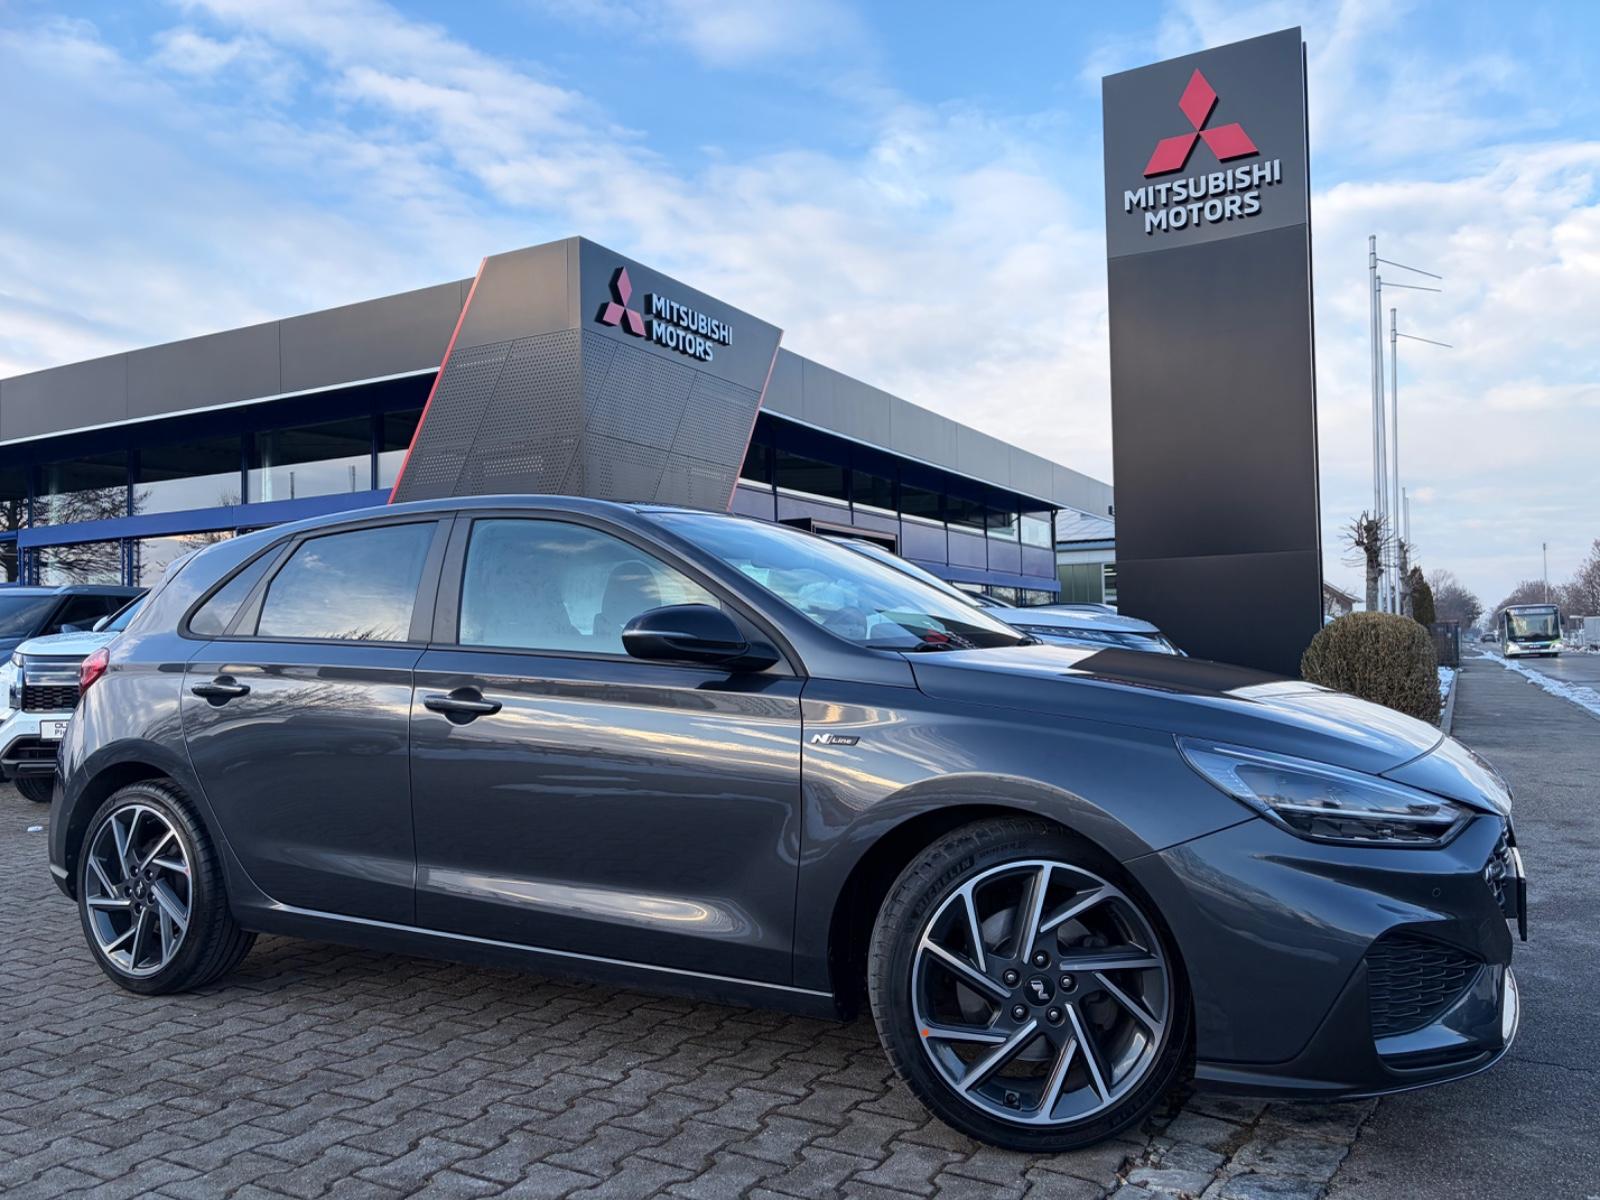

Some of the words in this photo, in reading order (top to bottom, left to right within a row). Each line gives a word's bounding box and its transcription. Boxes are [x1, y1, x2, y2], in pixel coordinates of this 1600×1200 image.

[1124, 159, 1281, 211] MITSUBISHI
[1145, 191, 1260, 233] MOTORS
[652, 292, 733, 345] MITSUBISHI
[652, 320, 713, 361] MOTORS
[811, 733, 831, 744] N
